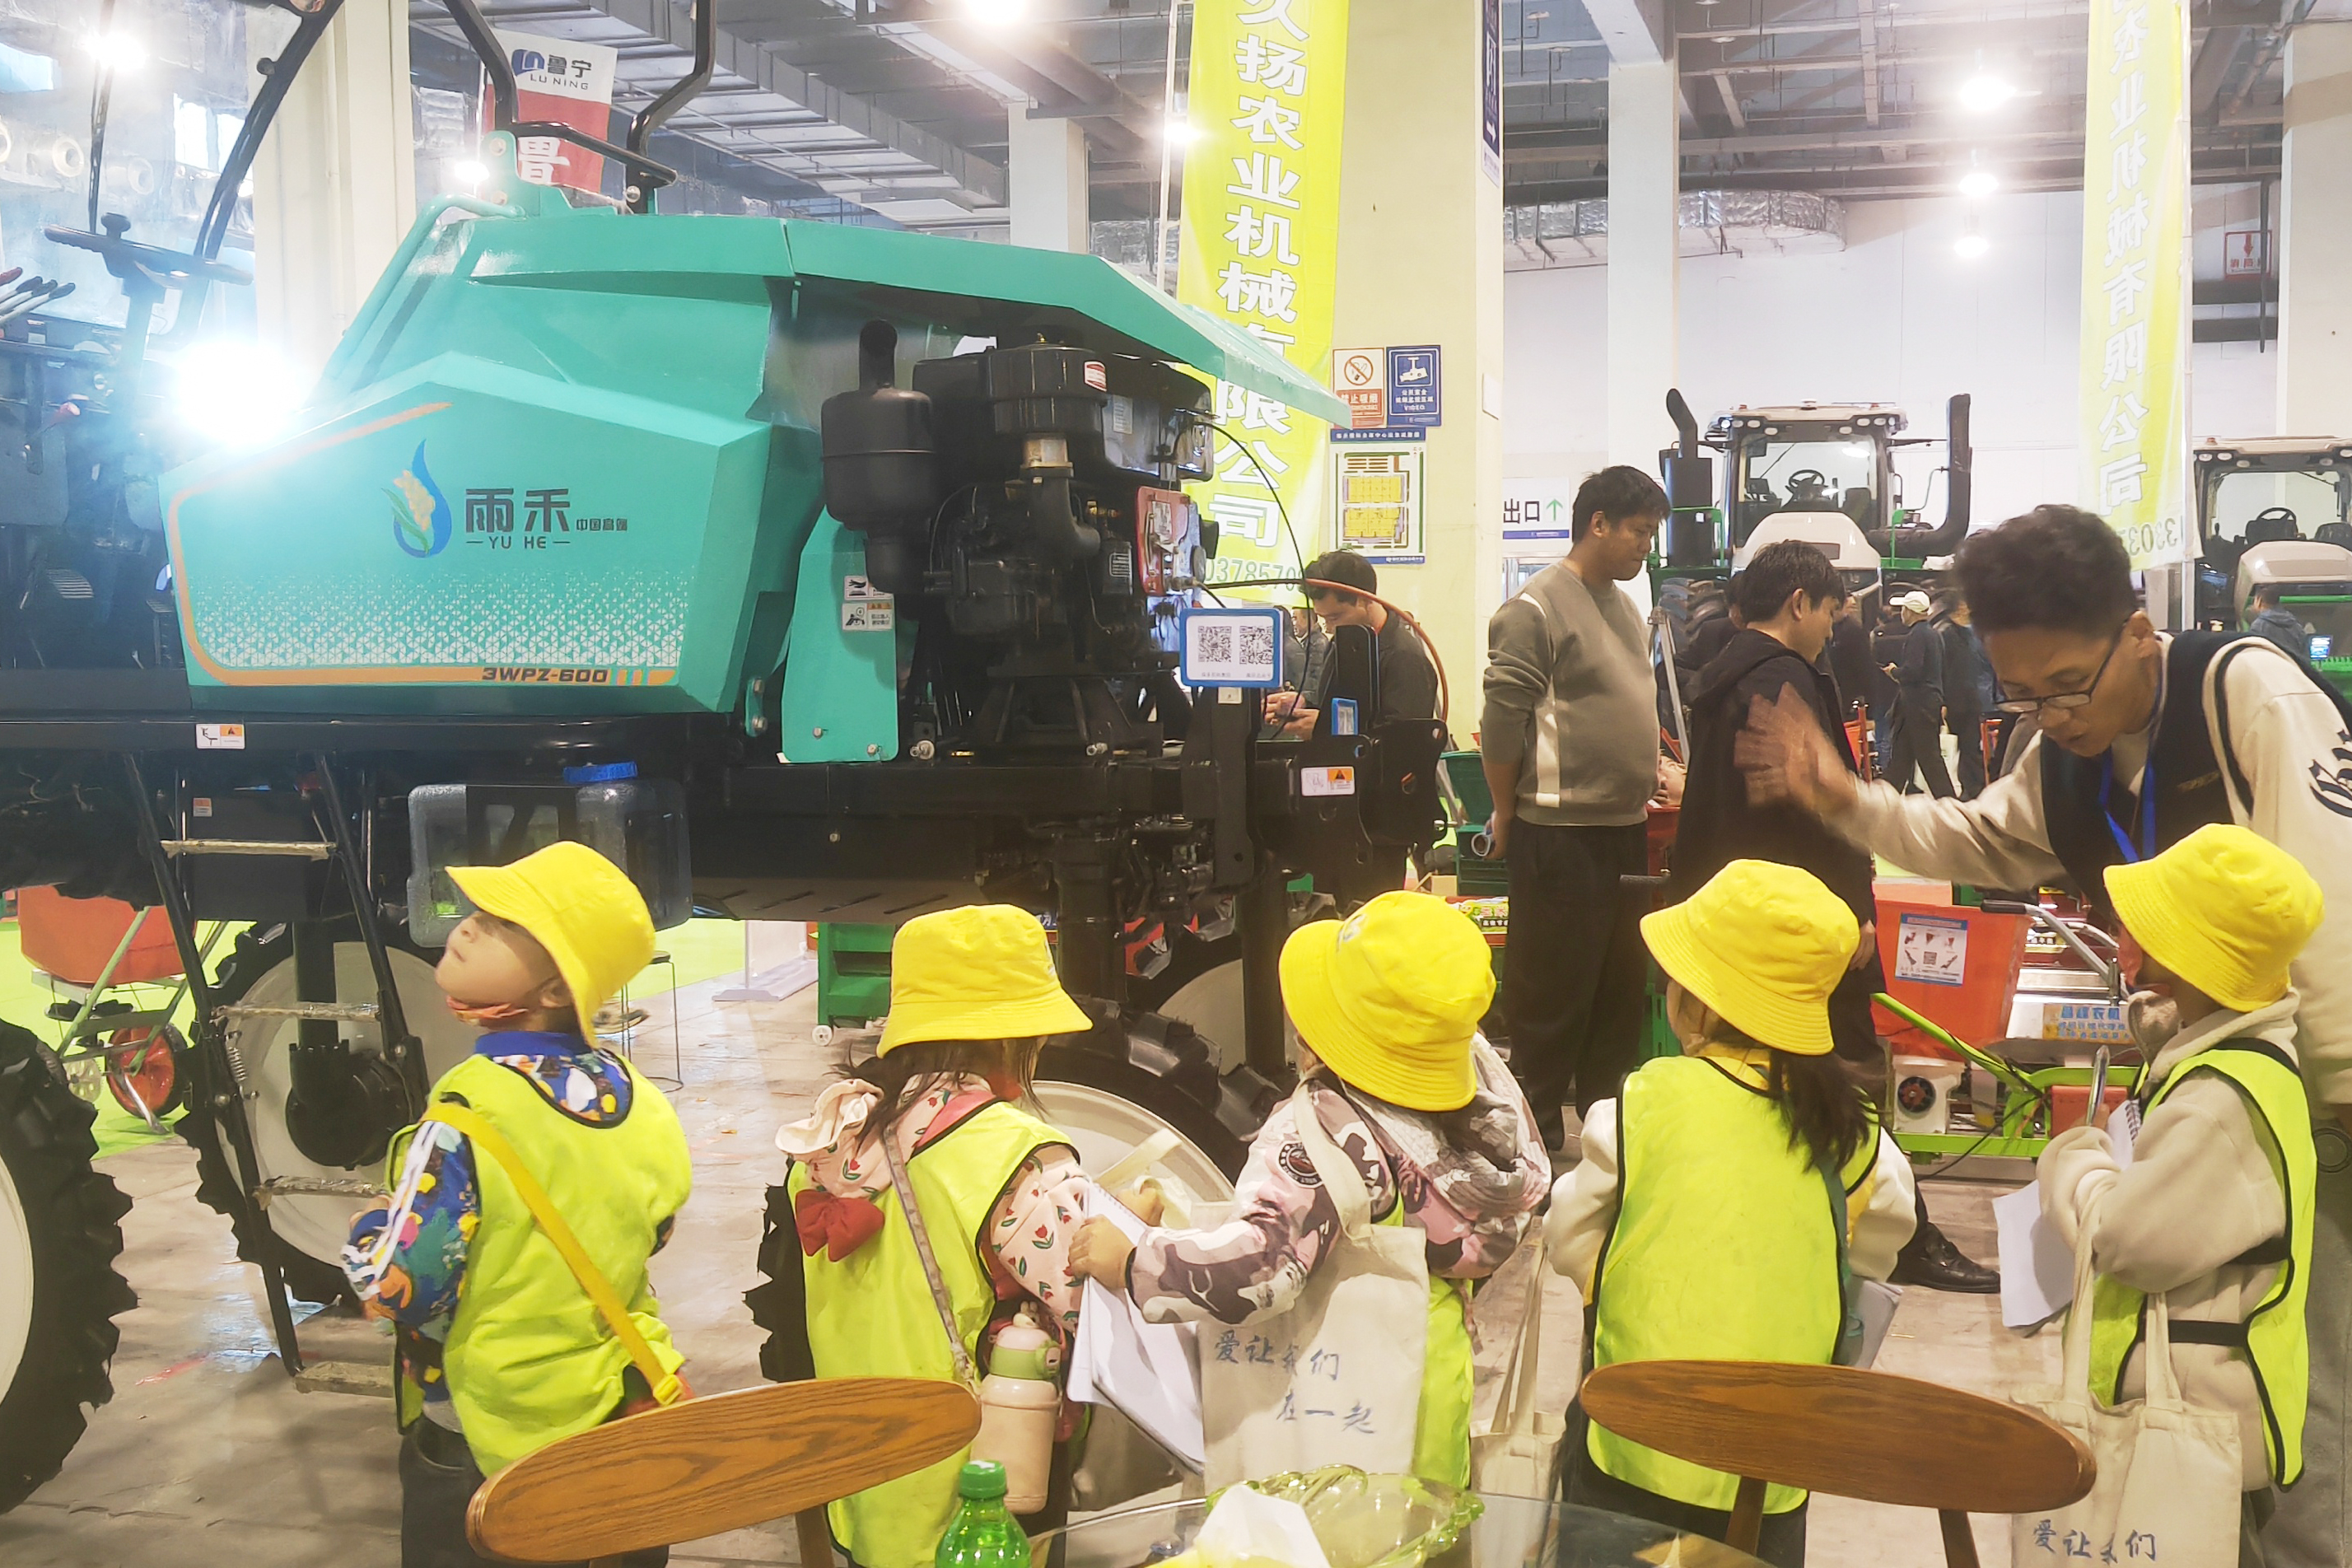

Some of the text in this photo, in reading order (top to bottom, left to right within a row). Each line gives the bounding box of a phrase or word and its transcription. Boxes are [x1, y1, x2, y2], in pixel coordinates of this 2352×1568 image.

[530, 73, 589, 90] LU NING
[465, 488, 571, 533] 雨禾
[1503, 498, 1540, 524] 出口
[489, 536, 547, 549] YU HE
[482, 666, 609, 684] 3WPZ-600
